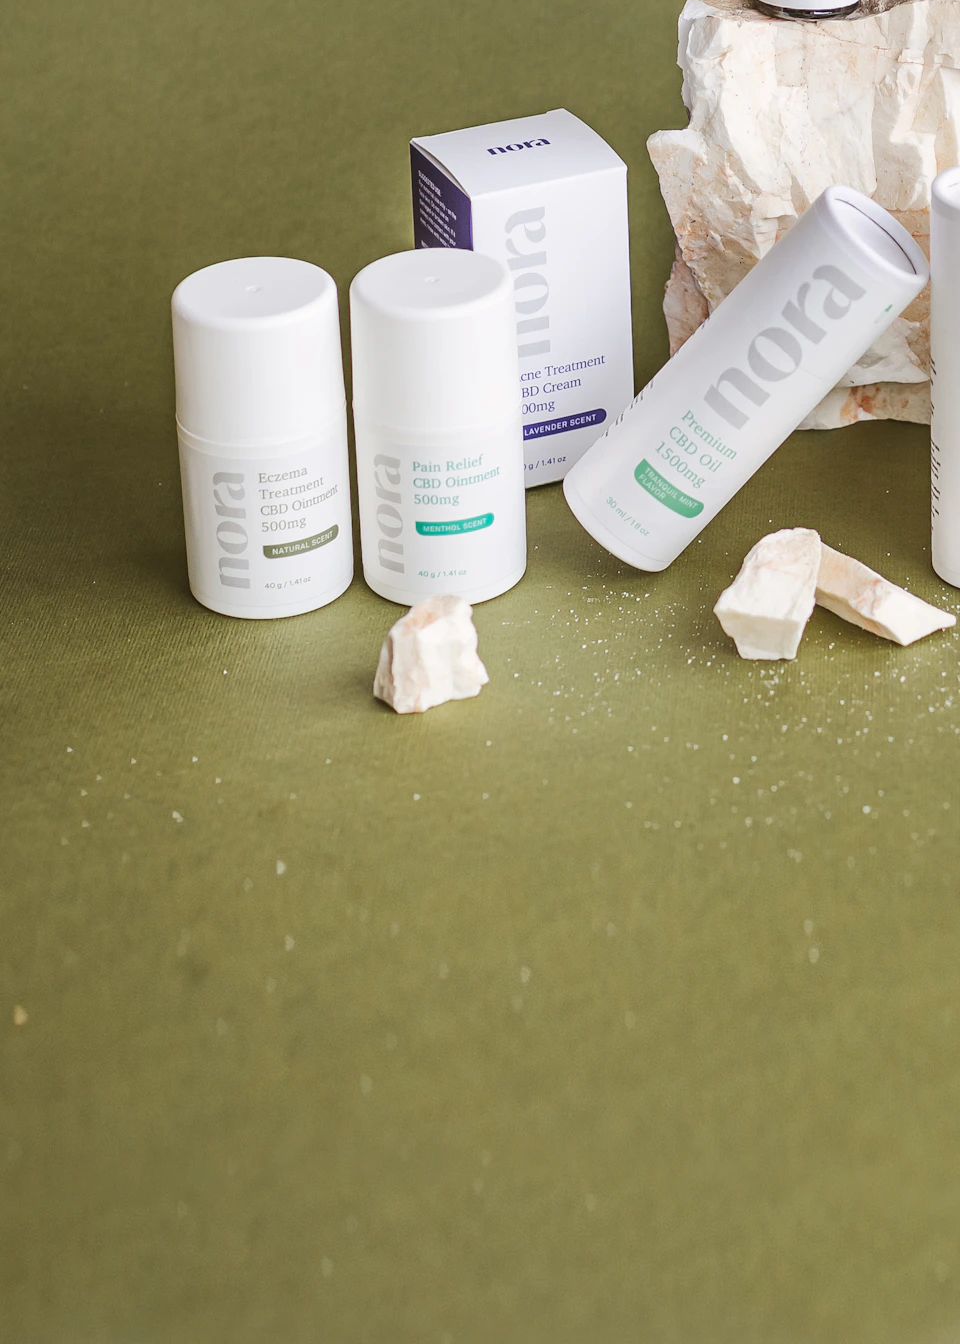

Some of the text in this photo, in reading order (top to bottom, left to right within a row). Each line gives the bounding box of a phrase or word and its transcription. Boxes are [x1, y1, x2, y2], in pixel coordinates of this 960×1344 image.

[487, 138, 551, 155] nora
[505, 206, 551, 358] nora
[703, 264, 867, 430] nora
[520, 355, 606, 382] cne Treatment
[522, 378, 581, 398] BD Cream
[522, 400, 555, 415] 00mg
[524, 414, 597, 436] LAVENDER SCENT
[681, 410, 738, 460] Premium
[541, 457, 556, 466] 1.41
[669, 426, 723, 473] CBD Oil
[412, 453, 484, 472] Pain Relief
[655, 441, 706, 489] 1500mg
[258, 467, 307, 483] Eczema
[413, 467, 501, 489] CBD Ointment
[259, 477, 324, 500] Treatment
[638, 474, 666, 501] FLAVOR
[644, 467, 698, 509] TRANQUIL MINT
[261, 484, 338, 517] CBD Ointment
[414, 494, 460, 506] 500mg
[262, 517, 307, 533] 500mg
[374, 454, 404, 574] nora
[423, 517, 487, 533] MENTHOL SCENT
[606, 496, 617, 509] 30
[615, 508, 625, 518] ml
[639, 528, 650, 536] oz
[212, 471, 250, 589] nora
[272, 530, 333, 555] NATURAL SCENT
[289, 578, 302, 586] 1.41
